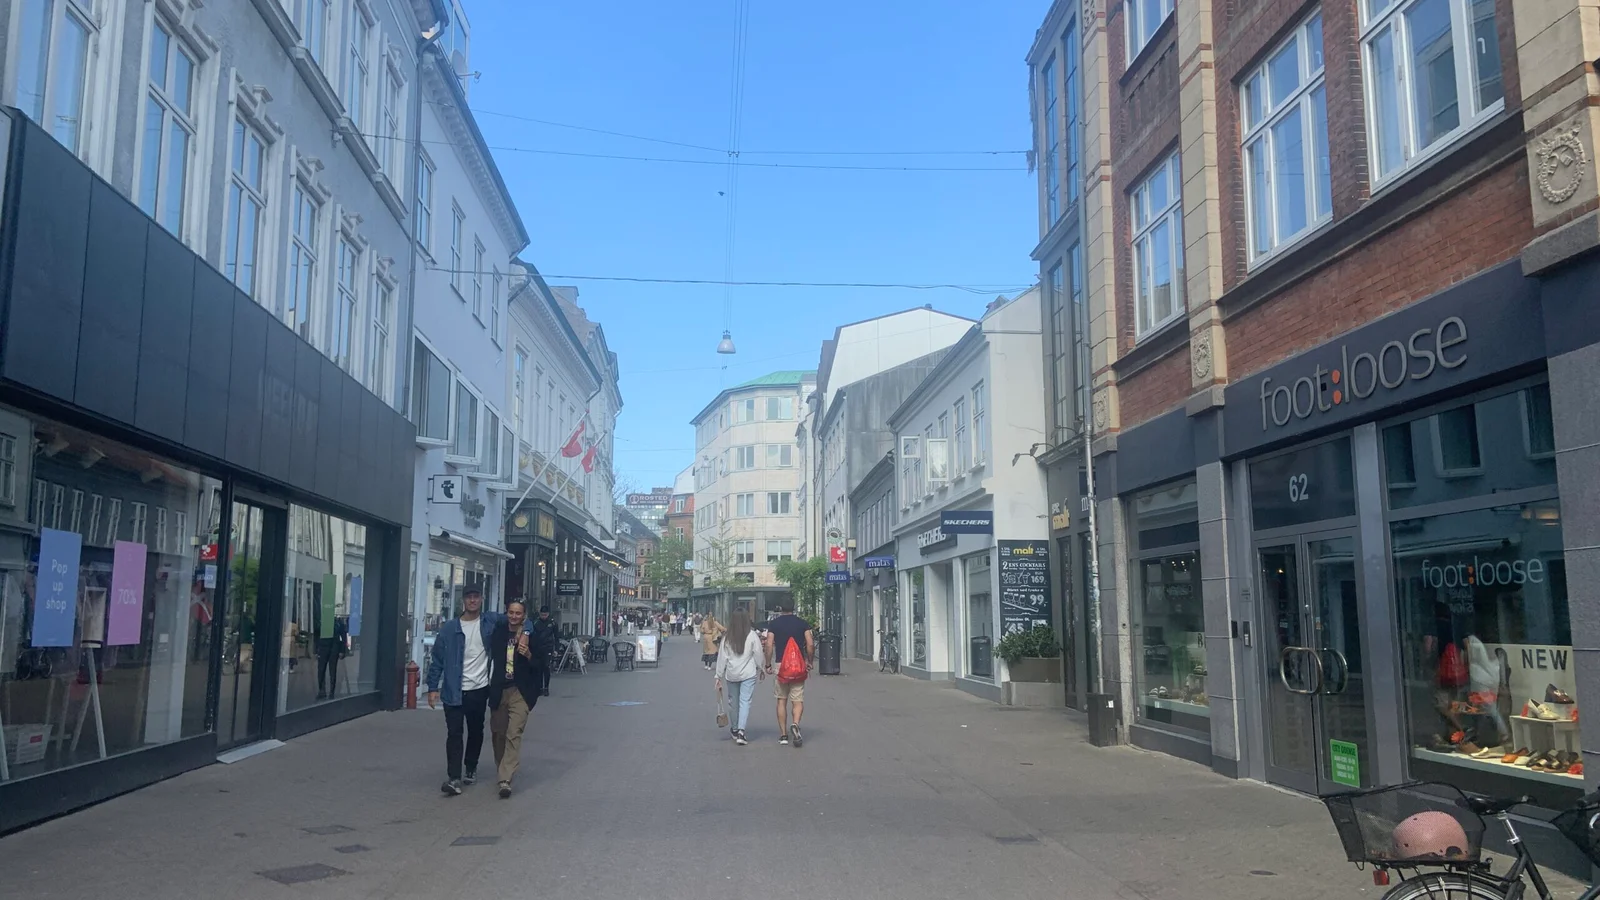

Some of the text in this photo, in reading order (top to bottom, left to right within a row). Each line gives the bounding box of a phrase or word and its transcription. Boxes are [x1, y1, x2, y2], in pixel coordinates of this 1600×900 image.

[1259, 316, 1468, 430] foot:loose
[1288, 473, 1309, 502] 62
[1013, 543, 1034, 555] malt
[51, 559, 68, 576] Pop
[868, 559, 891, 568] matas
[1002, 561, 1009, 570] 2
[1421, 555, 1543, 588] foot:loose
[52, 582, 64, 596] up
[118, 588, 137, 605] 70%
[45, 597, 67, 614] shop
[1521, 648, 1568, 671] NEW
